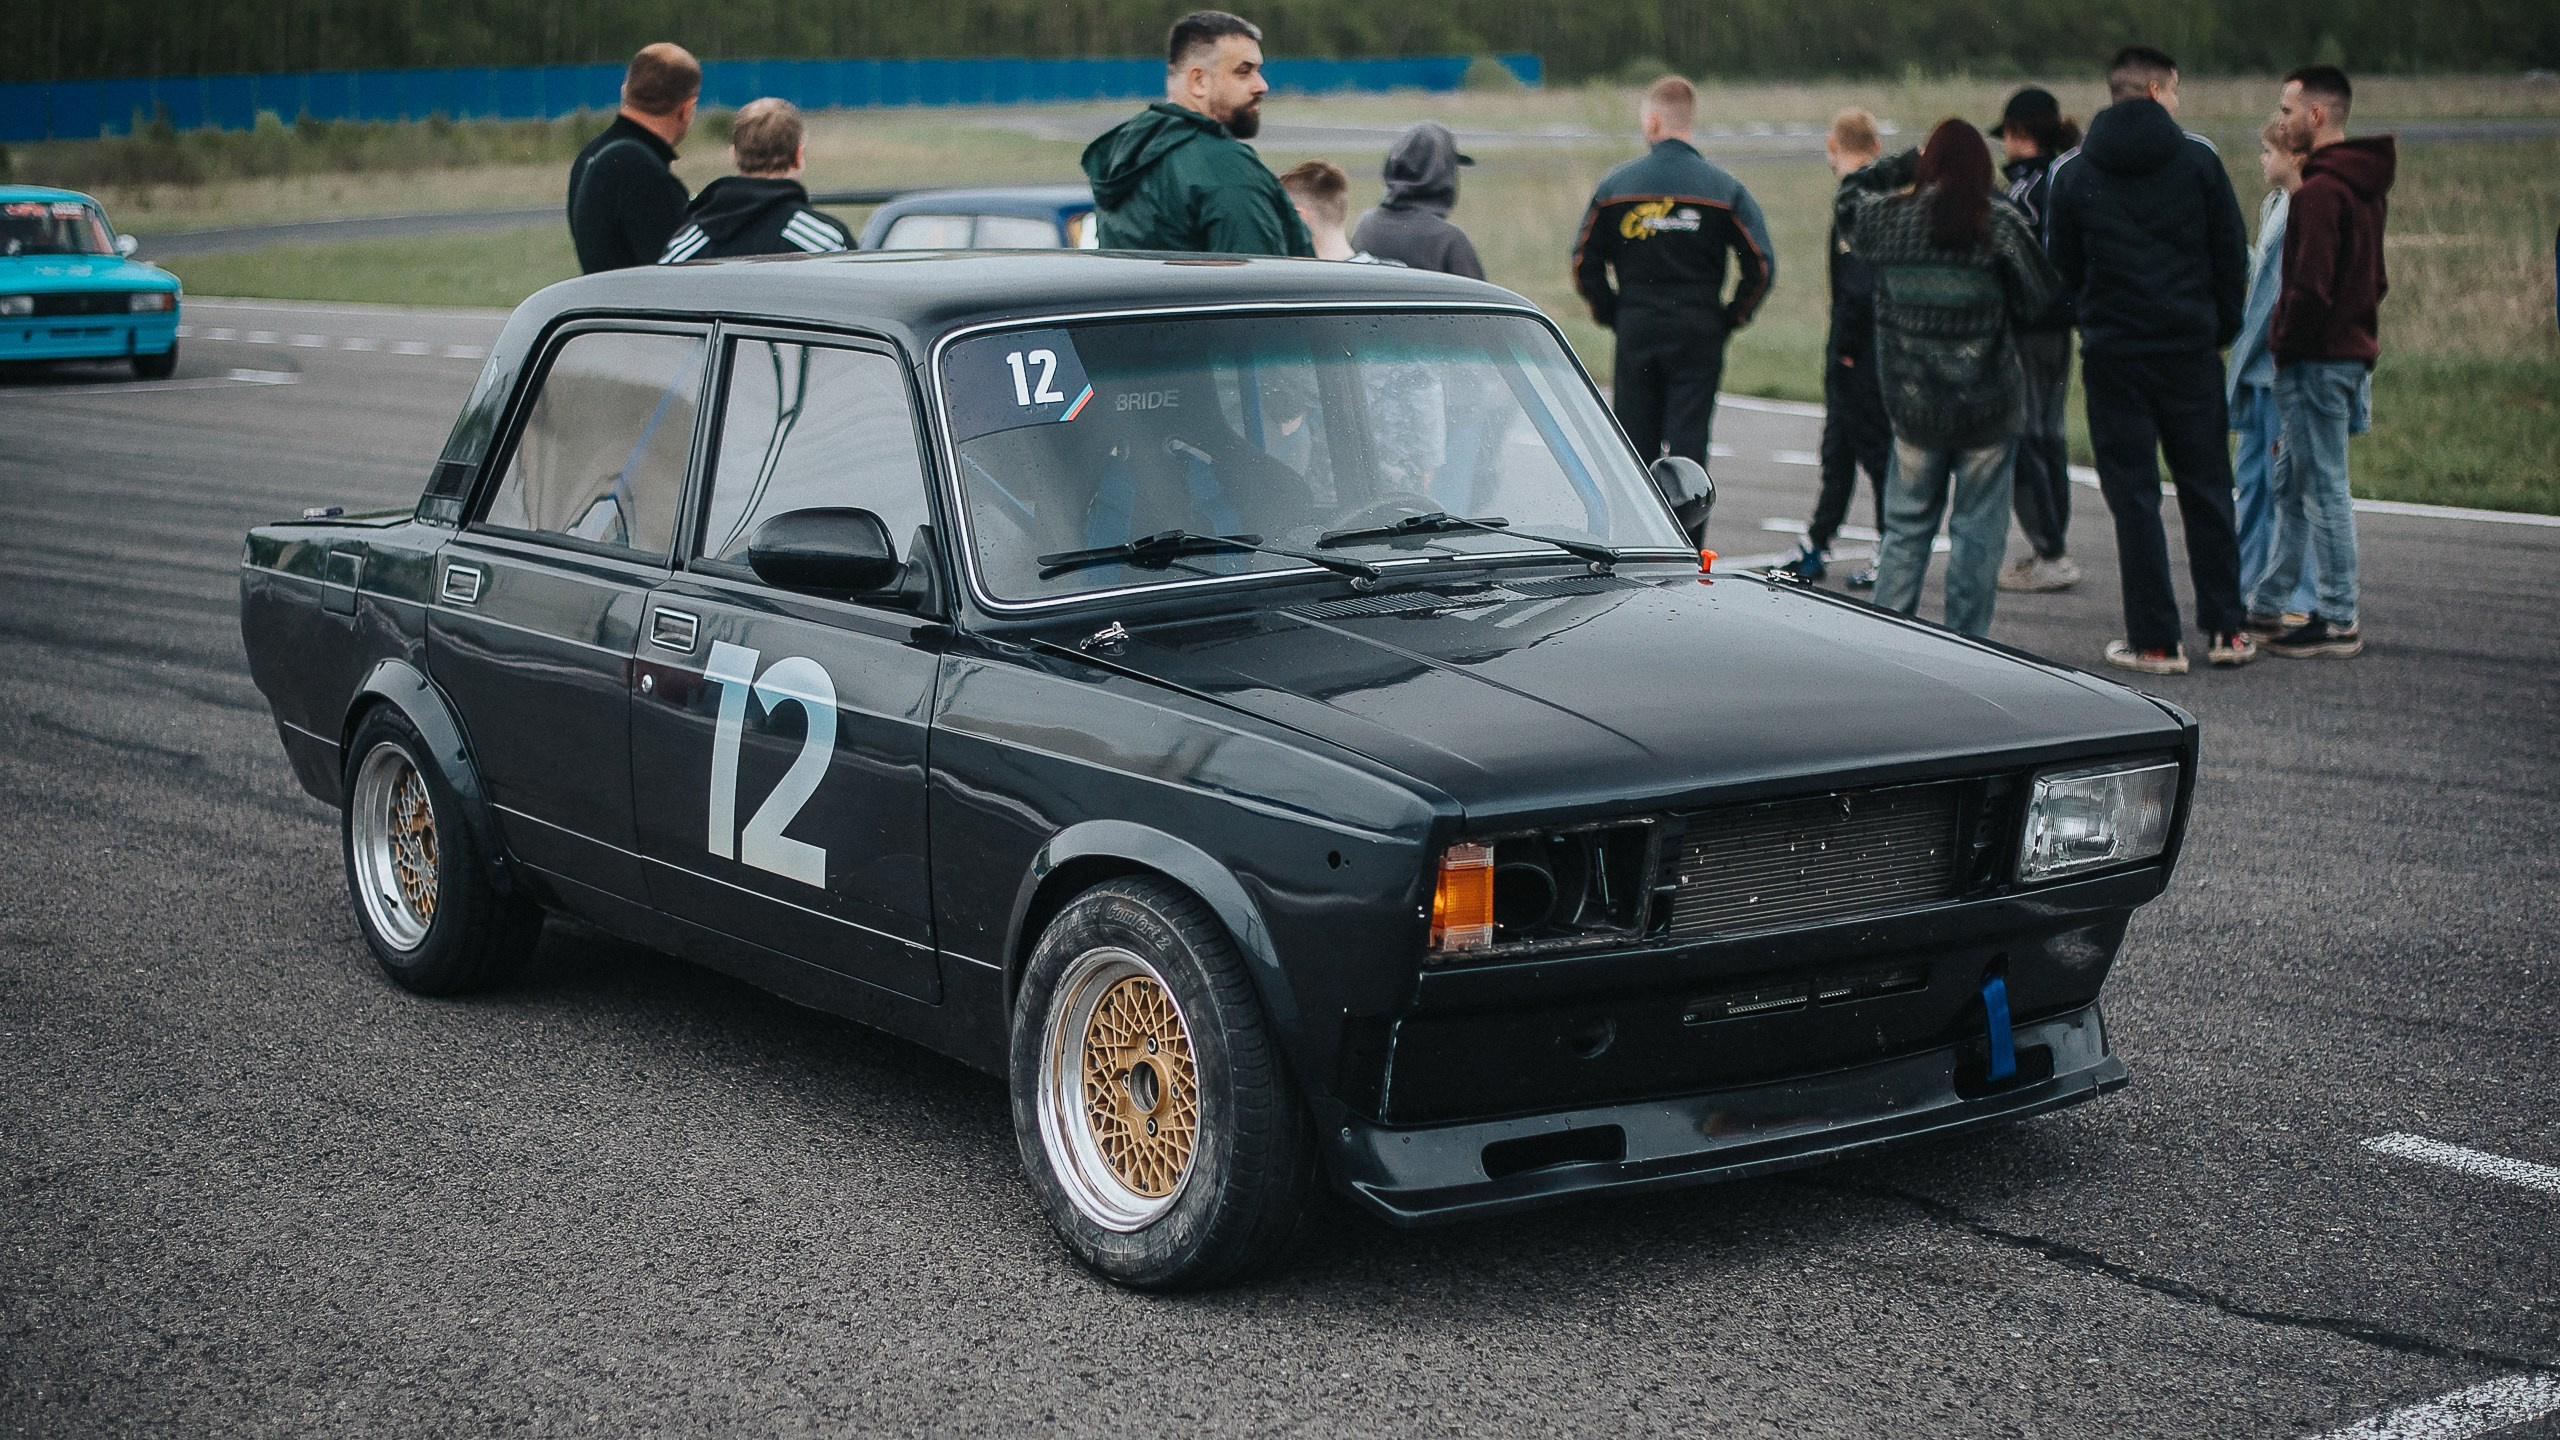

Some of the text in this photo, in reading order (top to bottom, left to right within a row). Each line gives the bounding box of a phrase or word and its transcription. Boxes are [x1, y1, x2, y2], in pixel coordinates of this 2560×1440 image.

[1006, 350, 1064, 406] 12
[1115, 389, 1180, 412] BRIDE
[703, 640, 838, 890] 12
[1105, 902, 1162, 939] Comfort
[1155, 935, 1173, 952] 2
